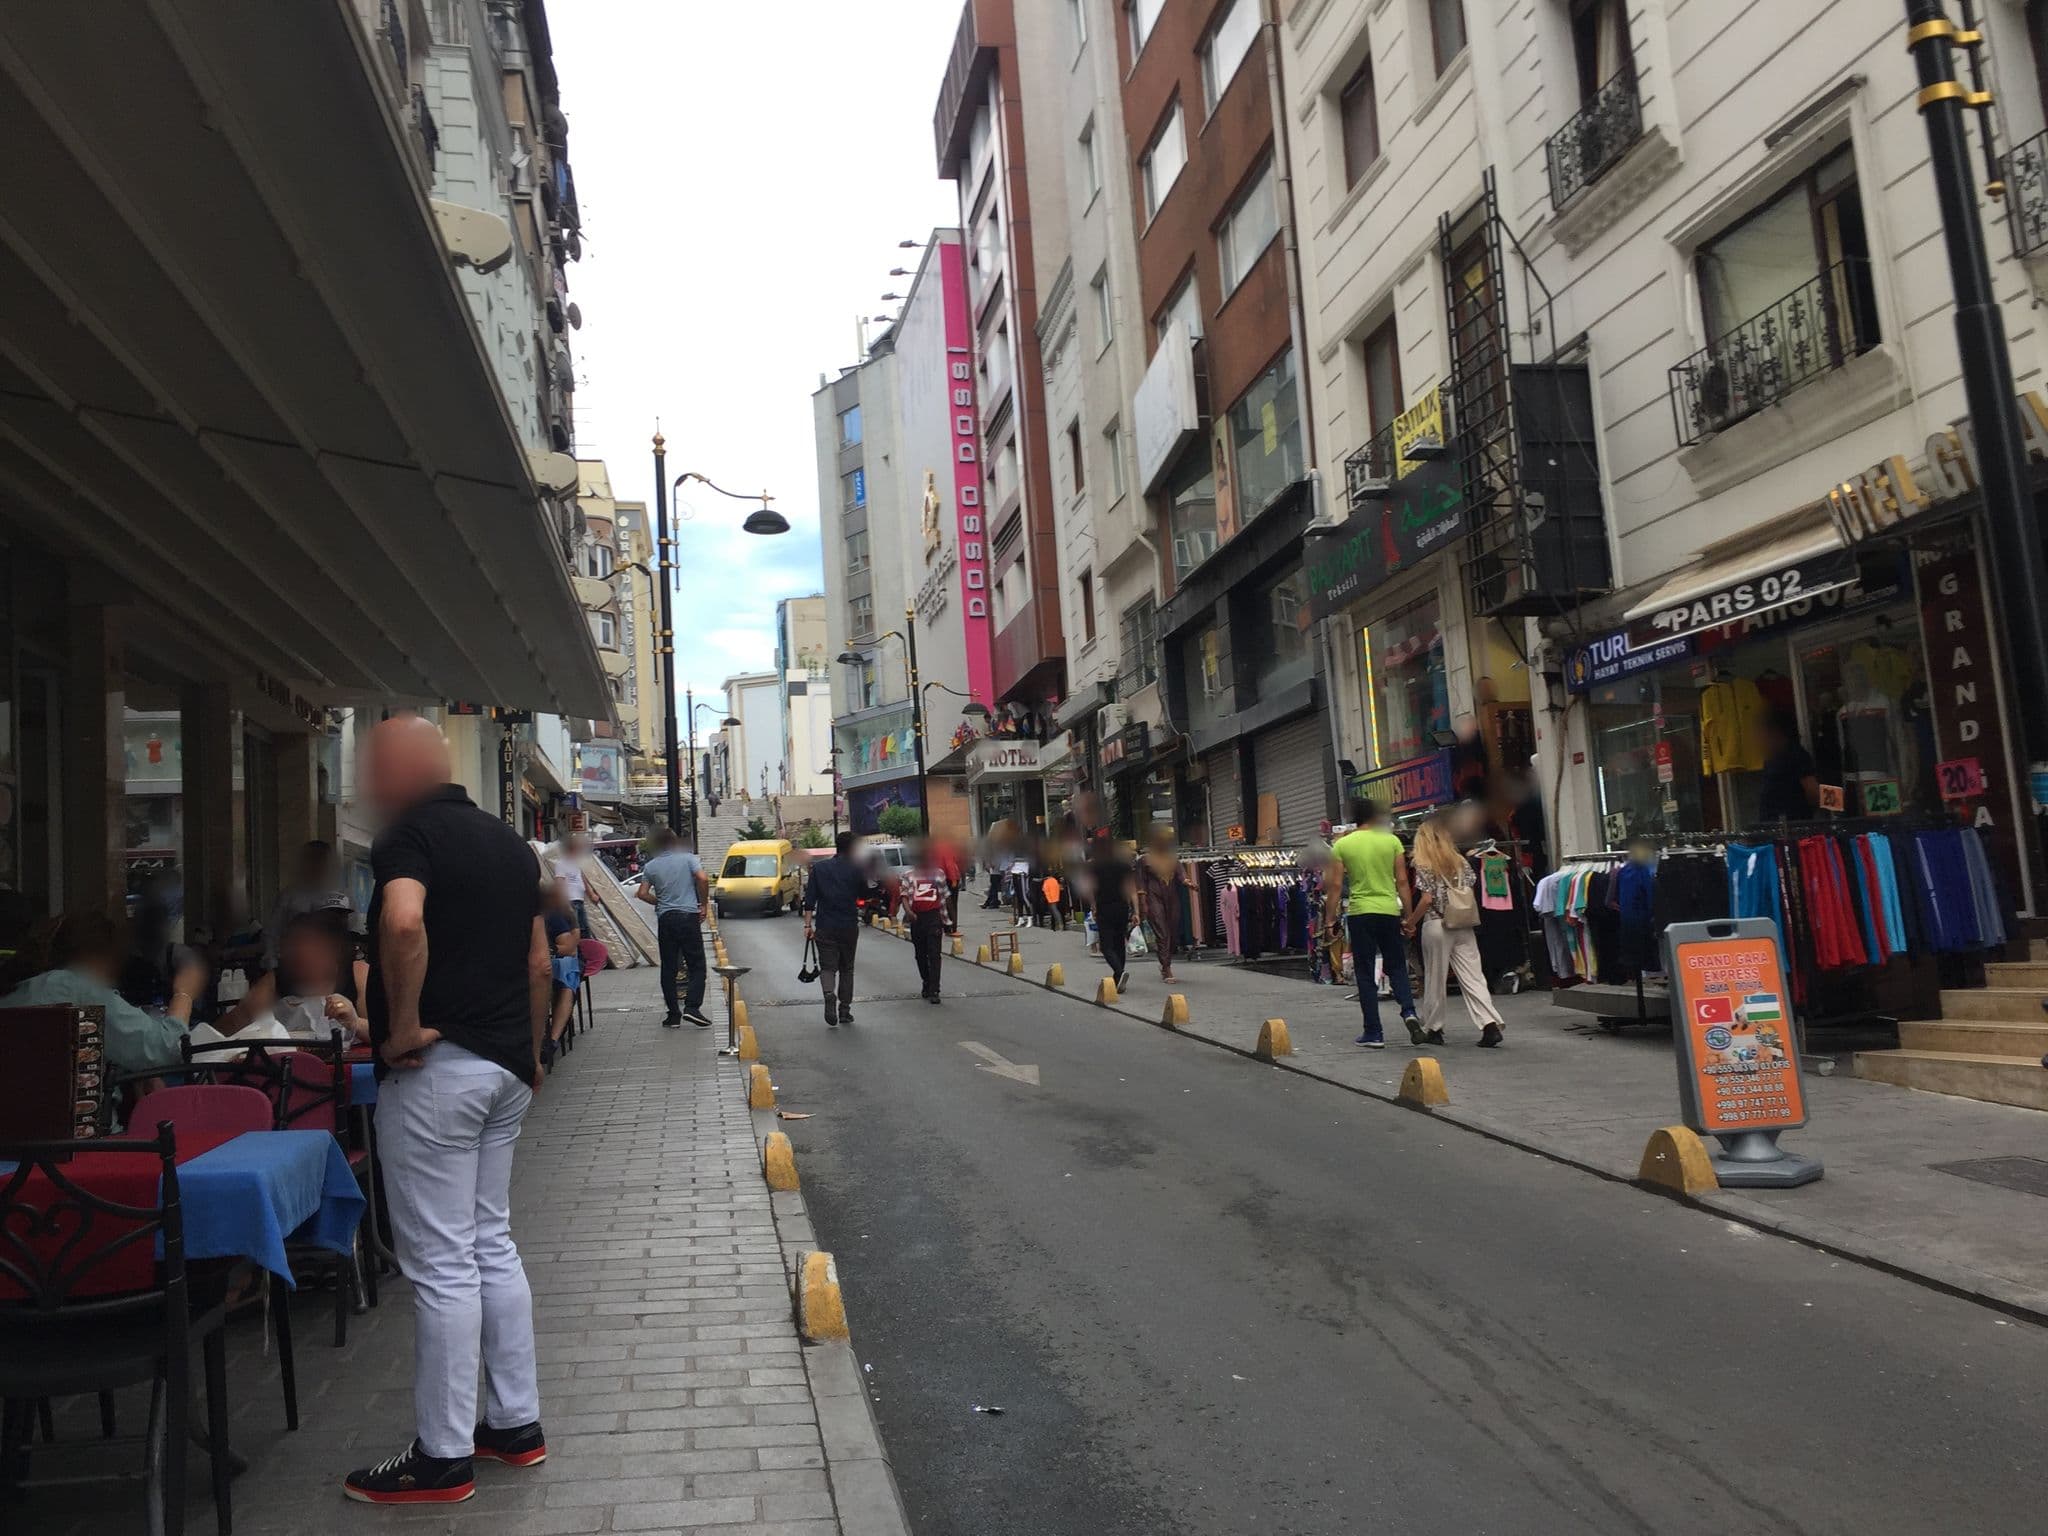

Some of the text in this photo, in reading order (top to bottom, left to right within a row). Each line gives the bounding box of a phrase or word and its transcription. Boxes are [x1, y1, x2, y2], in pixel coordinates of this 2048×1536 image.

[1670, 585, 1756, 633] PARS
[1760, 568, 1803, 602] 02
[988, 746, 1038, 768] HOTEL
[1688, 951, 1769, 969] GRAND GARA
[1704, 967, 1760, 982] EXPRESS
